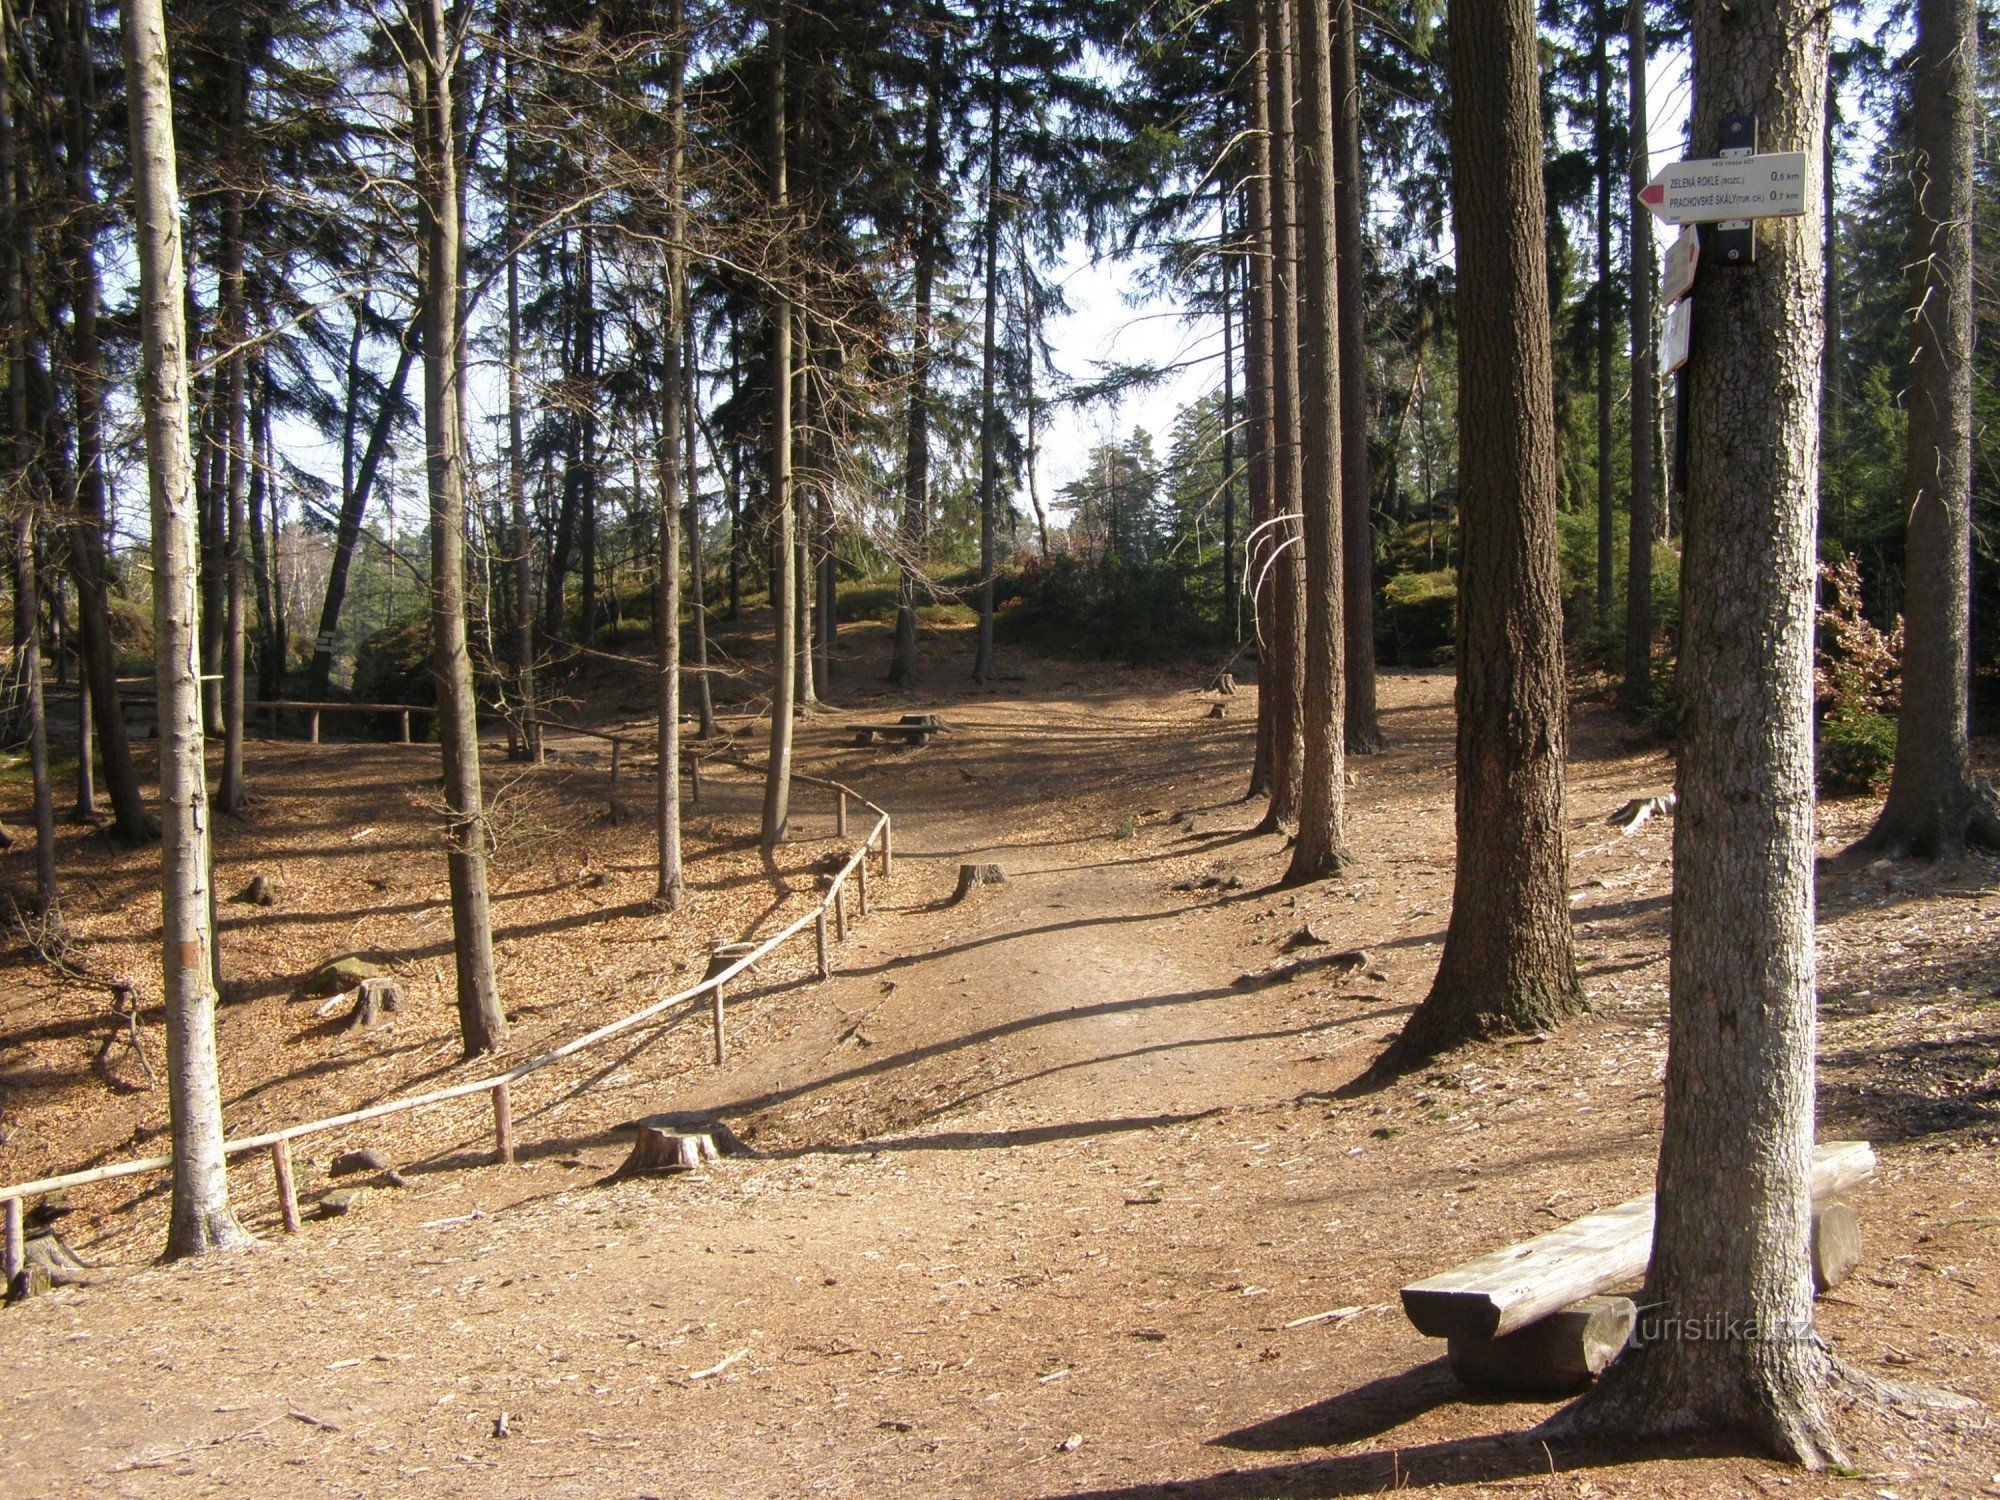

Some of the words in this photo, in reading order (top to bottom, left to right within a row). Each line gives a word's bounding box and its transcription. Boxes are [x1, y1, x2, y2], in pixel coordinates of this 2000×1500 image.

[1670, 174, 1695, 189] ZELENÁ
[1697, 175, 1719, 187] ROKLE
[1770, 171, 1785, 182] 0,5
[1787, 173, 1799, 181] km
[1670, 193, 1713, 208] PRACHOVSKÉ
[1769, 190, 1783, 202] 0,7
